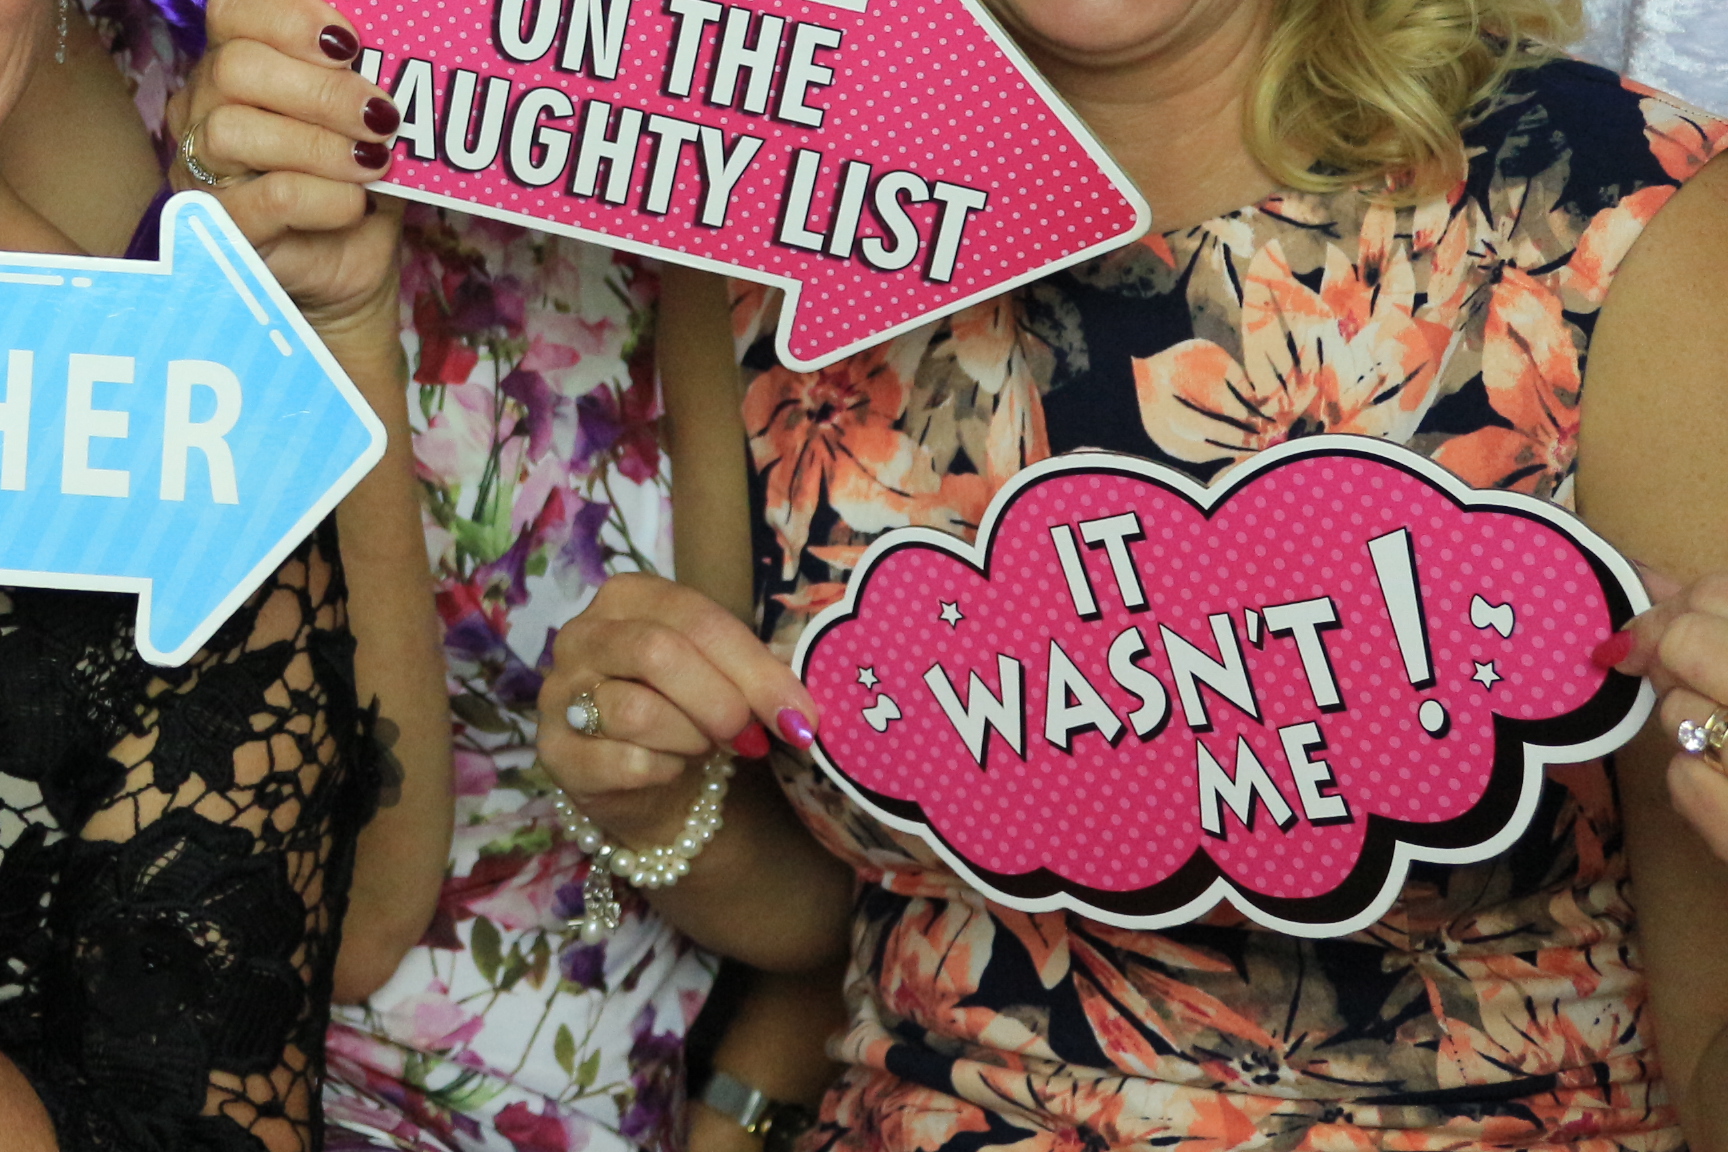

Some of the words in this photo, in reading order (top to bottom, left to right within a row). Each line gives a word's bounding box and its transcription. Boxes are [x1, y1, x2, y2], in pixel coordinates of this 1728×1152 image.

[354, 47, 764, 228] AUGHTY
[778, 148, 988, 283] LIST
[1049, 511, 1146, 617] IT
[922, 596, 1341, 765] WASN'T
[1195, 720, 1350, 835] ME
